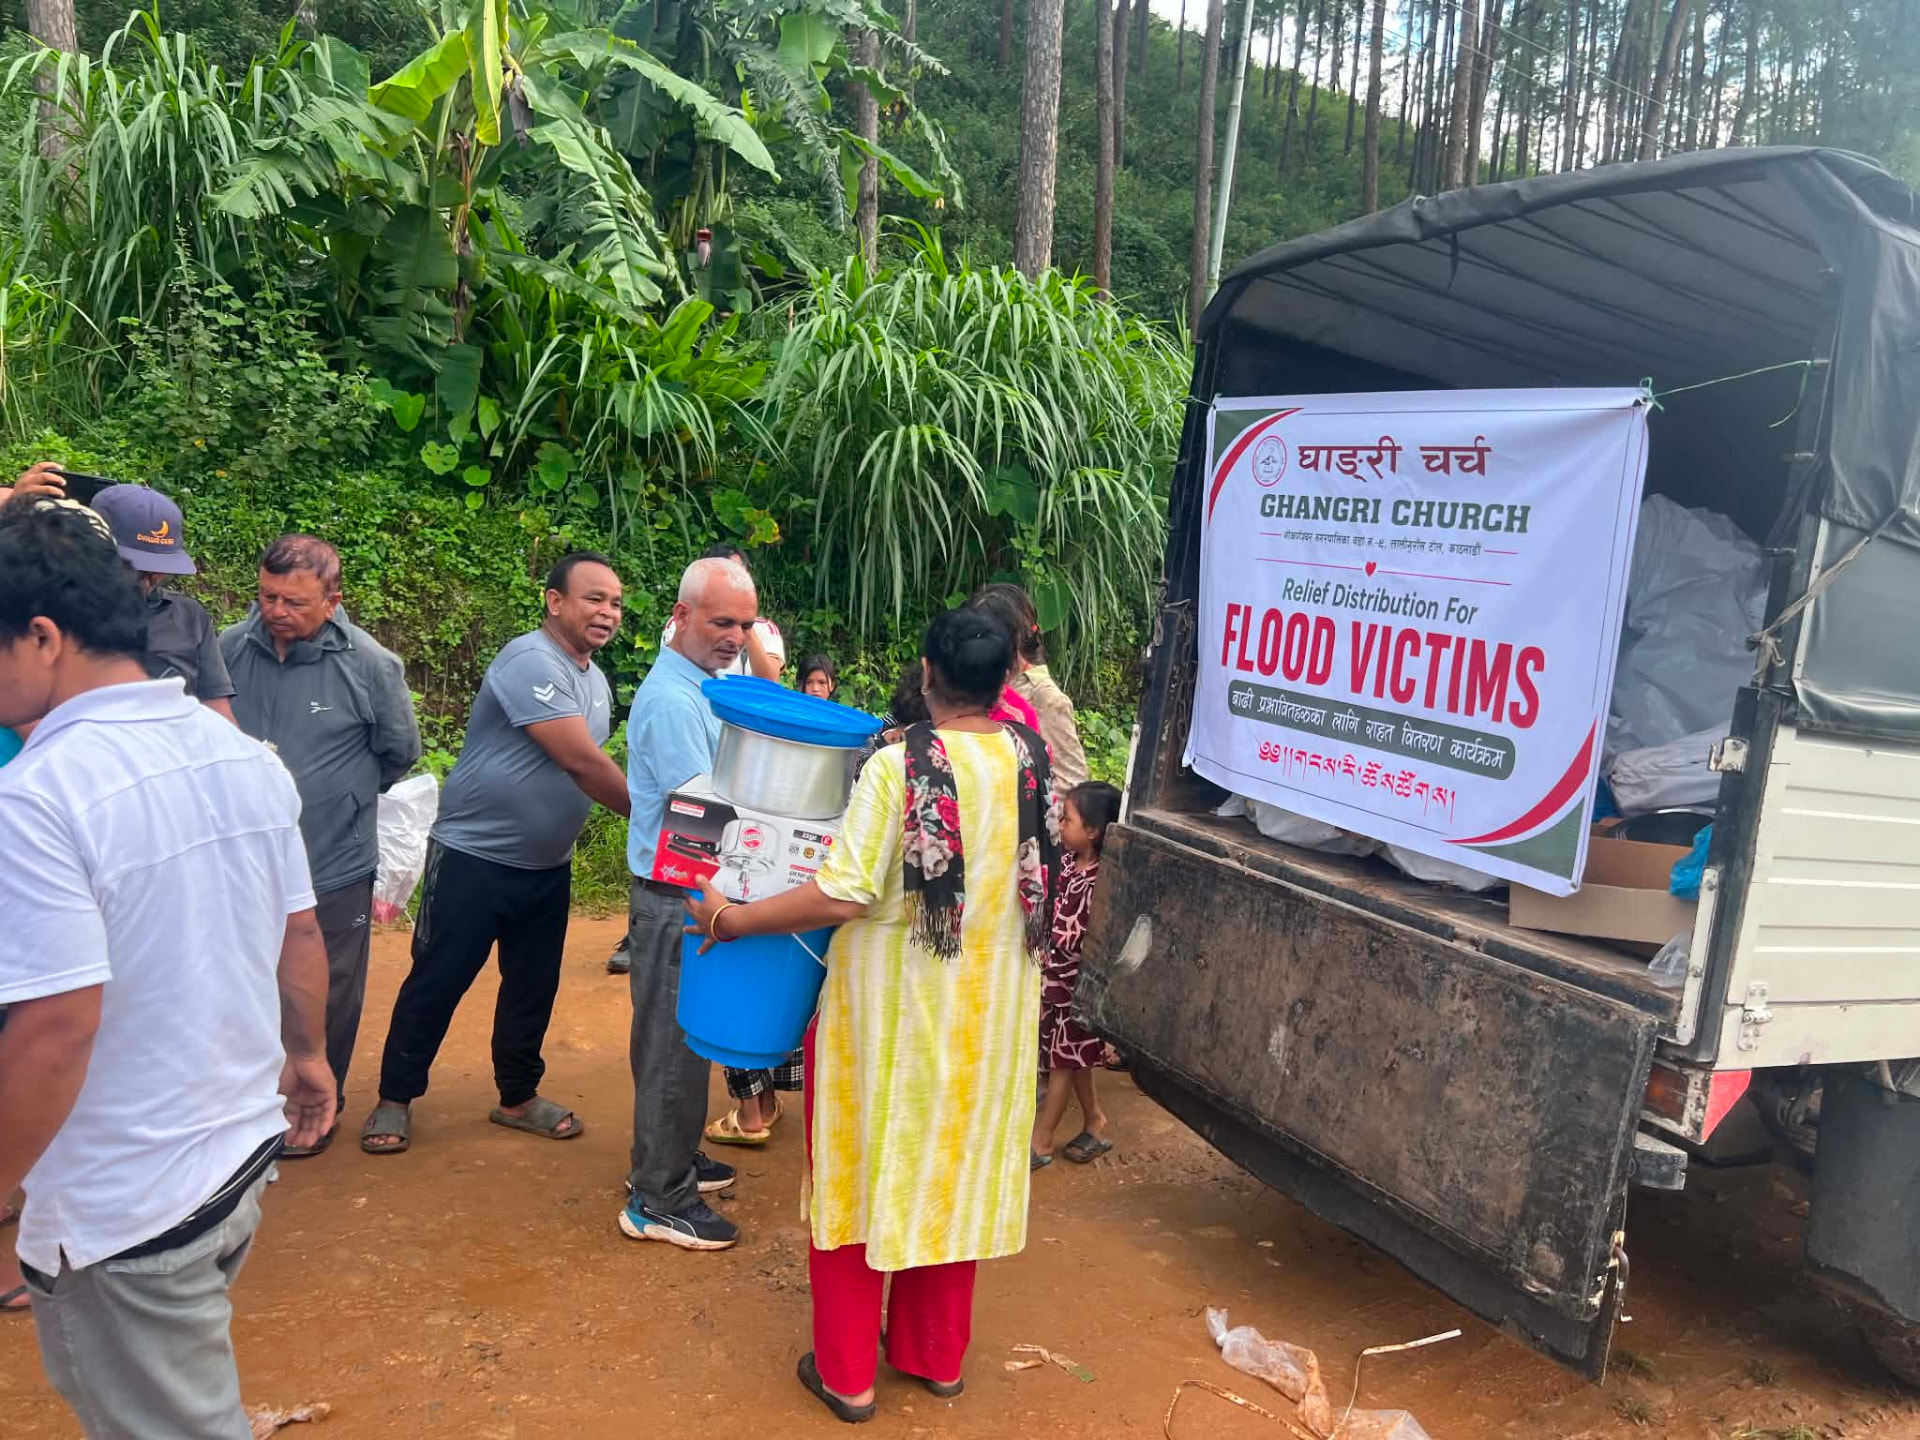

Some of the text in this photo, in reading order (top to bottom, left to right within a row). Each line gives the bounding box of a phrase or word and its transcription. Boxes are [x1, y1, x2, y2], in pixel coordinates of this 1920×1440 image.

[1419, 435, 1492, 476] चर्च
[1260, 494, 1531, 533] GHANGRI CHURCH
[1282, 577, 1479, 625] Relief Distribution For
[1221, 602, 1545, 729] FLOOD VICTIMS
[1332, 708, 1361, 736] लागि
[1365, 720, 1396, 743] राहत
[1401, 720, 1445, 755] वितरण
[1449, 737, 1507, 770] कार्यक्रम
